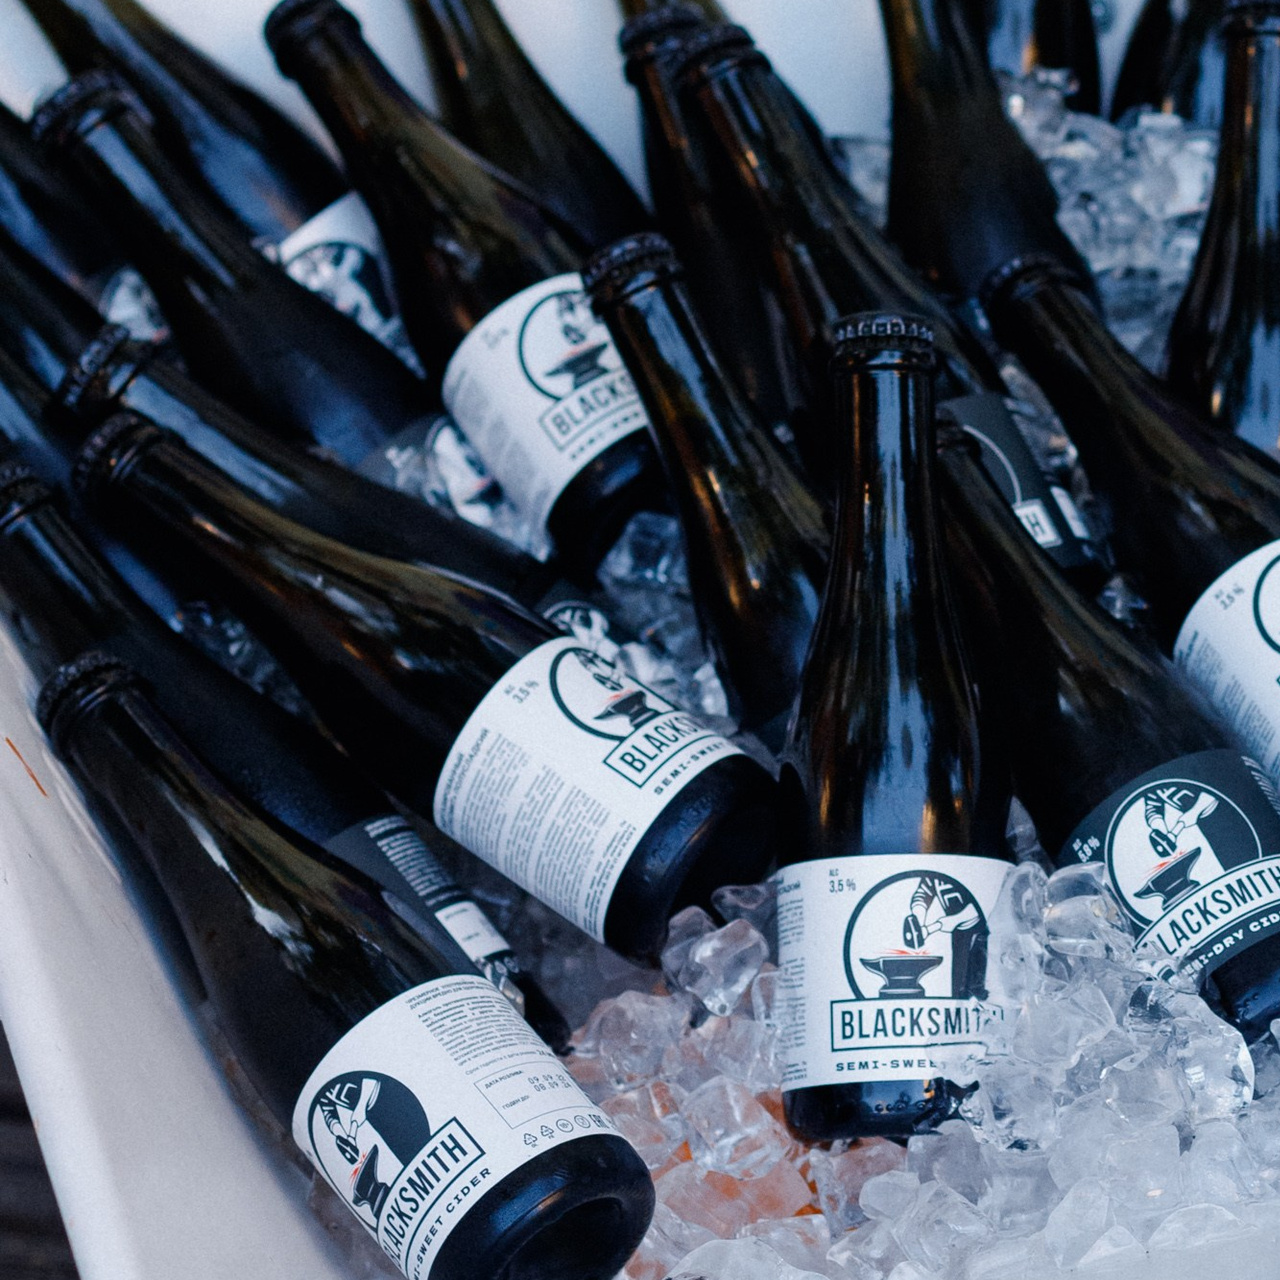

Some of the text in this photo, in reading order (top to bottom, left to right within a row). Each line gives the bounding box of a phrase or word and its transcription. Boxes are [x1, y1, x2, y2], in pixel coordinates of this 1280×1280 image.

[551, 374, 636, 437] BLACKS
[619, 715, 699, 774] BLACKS
[828, 868, 840, 877] ALC
[841, 1006, 985, 1041] BLACKSMIT
[484, 1077, 499, 1090] ДАТА
[445, 1167, 492, 1214] CIDER
